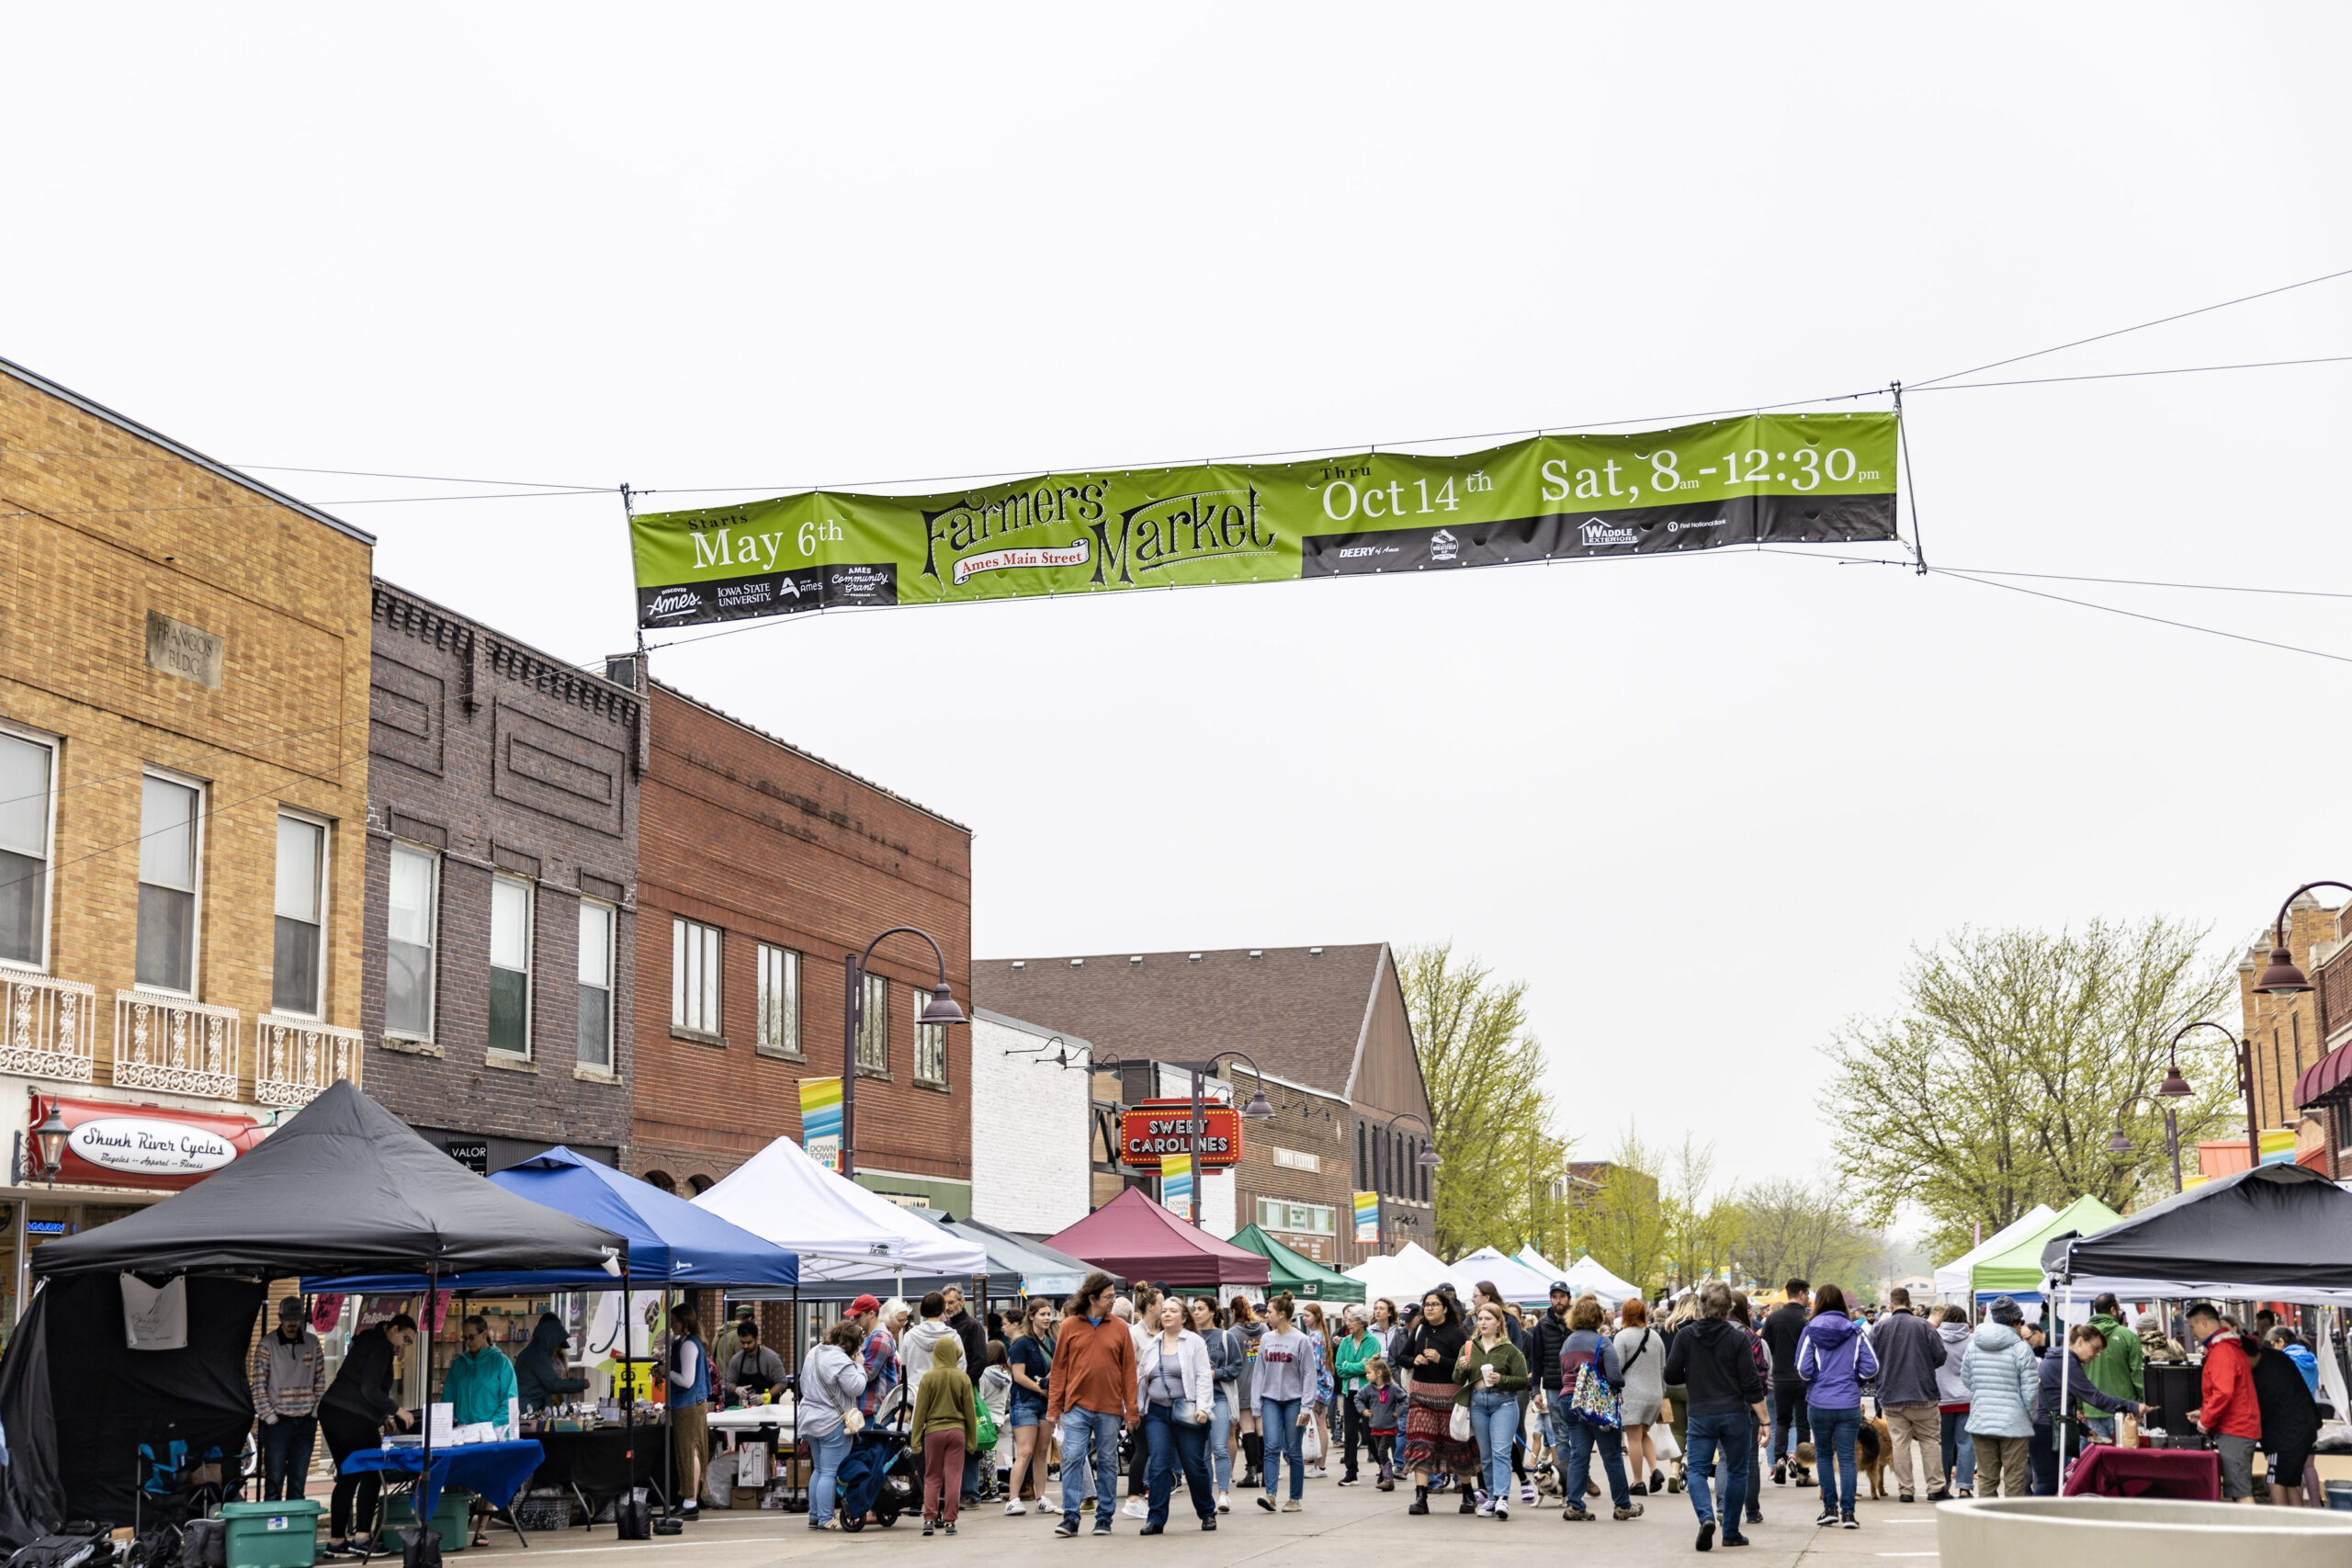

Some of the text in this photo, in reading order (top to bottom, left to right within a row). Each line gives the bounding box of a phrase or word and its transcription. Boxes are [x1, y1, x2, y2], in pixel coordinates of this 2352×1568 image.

[1320, 466, 1372, 480] Thru
[1541, 458, 1639, 504] Sat,
[1323, 479, 1407, 521] Oct
[688, 514, 749, 530] Starts
[1714, 518, 1726, 526] Bank
[1088, 479, 1278, 589] Market
[1586, 525, 1634, 538] WADDLE
[689, 519, 844, 571] May 6th
[1589, 536, 1638, 544] EXTERIORS
[1339, 546, 1375, 558] DEERY
[962, 550, 1082, 575] Ames Main Street
[831, 570, 889, 585] Community
[848, 567, 872, 575] AMES
[662, 587, 687, 595] DISCOVER
[718, 583, 771, 598] IOWA STATE
[844, 582, 876, 593] Grant
[646, 592, 701, 616] Ames
[156, 621, 213, 657] FRANGOS
[1148, 1119, 1208, 1134] SWEET
[137, 1131, 175, 1152] River
[181, 1135, 225, 1159] Cycles
[451, 1146, 487, 1157] VALOR
[1129, 1137, 1228, 1153] CAROLINES
[100, 1152, 130, 1164] Bicycles
[140, 1156, 169, 1167] Apparel
